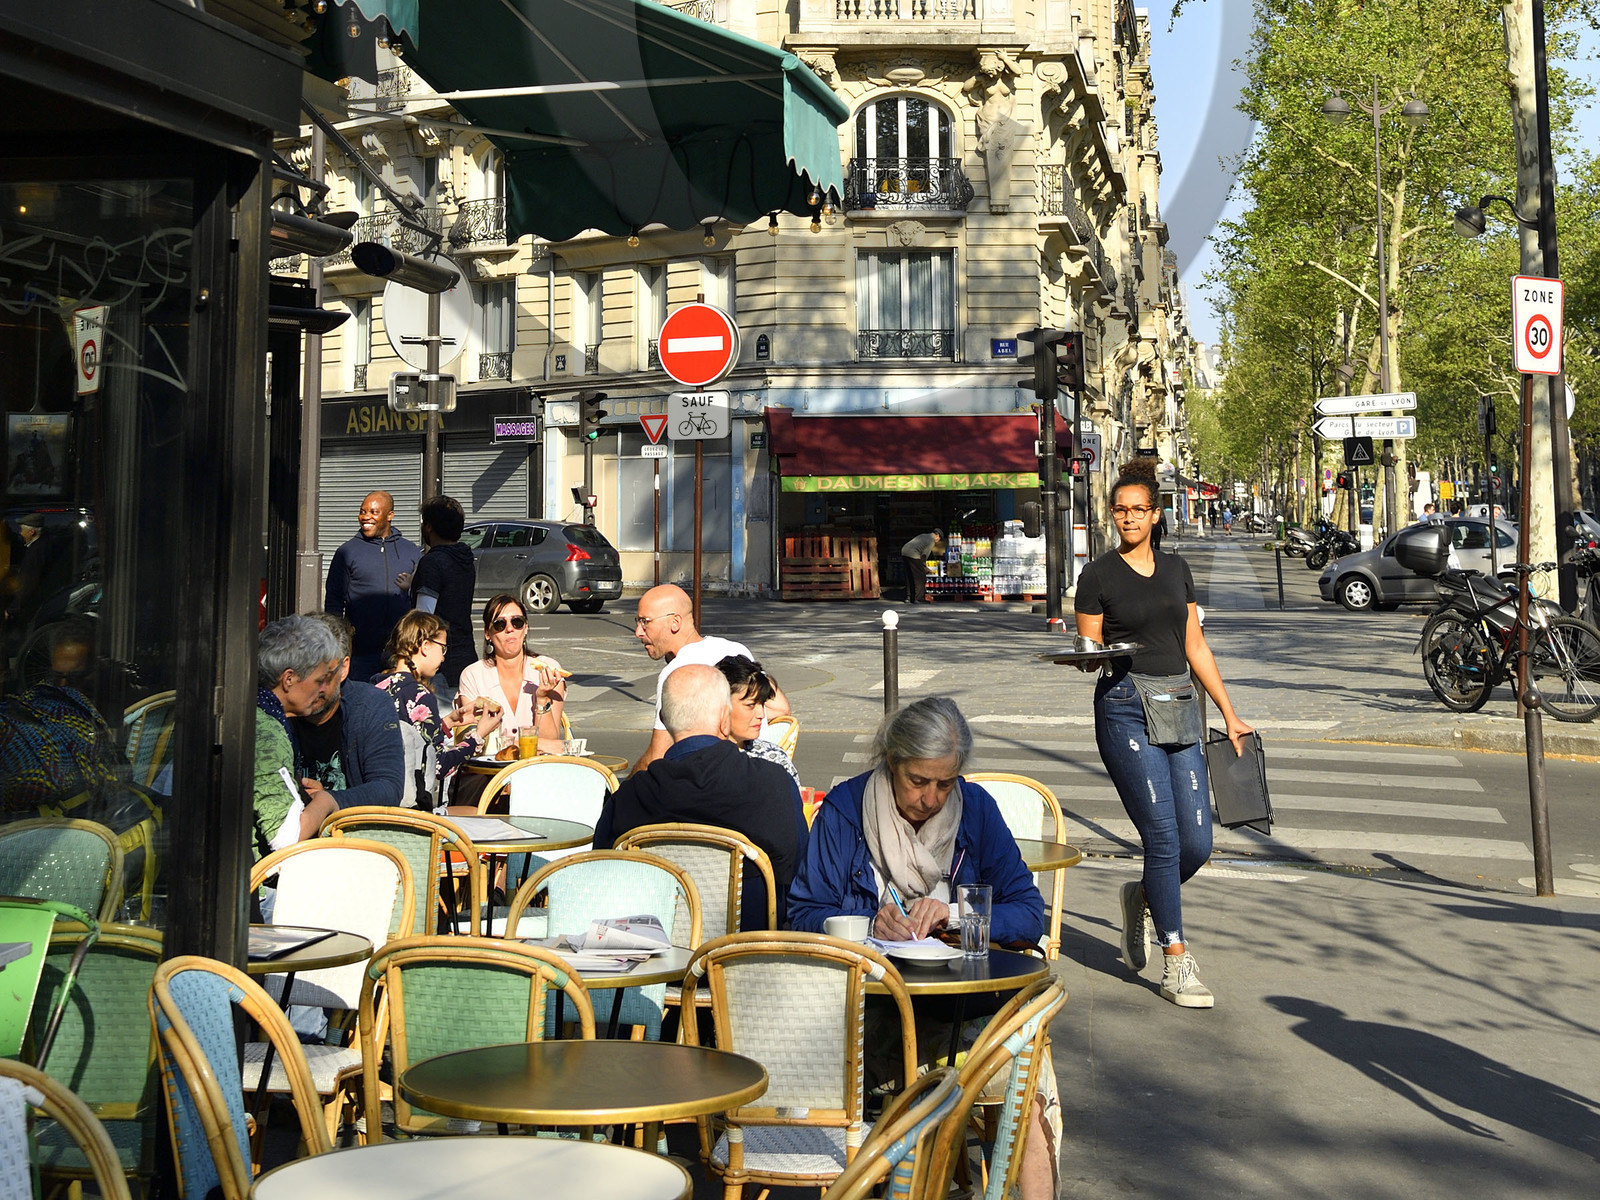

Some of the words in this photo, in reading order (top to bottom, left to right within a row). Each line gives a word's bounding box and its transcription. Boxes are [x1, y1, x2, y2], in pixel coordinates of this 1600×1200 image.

[1524, 289, 1553, 304] ZONE
[1531, 327, 1547, 346] 30
[682, 396, 714, 407] SAUF
[346, 405, 402, 434] ASIAN
[496, 422, 535, 436] MASSAGES
[817, 475, 947, 490] DAUMESNIL
